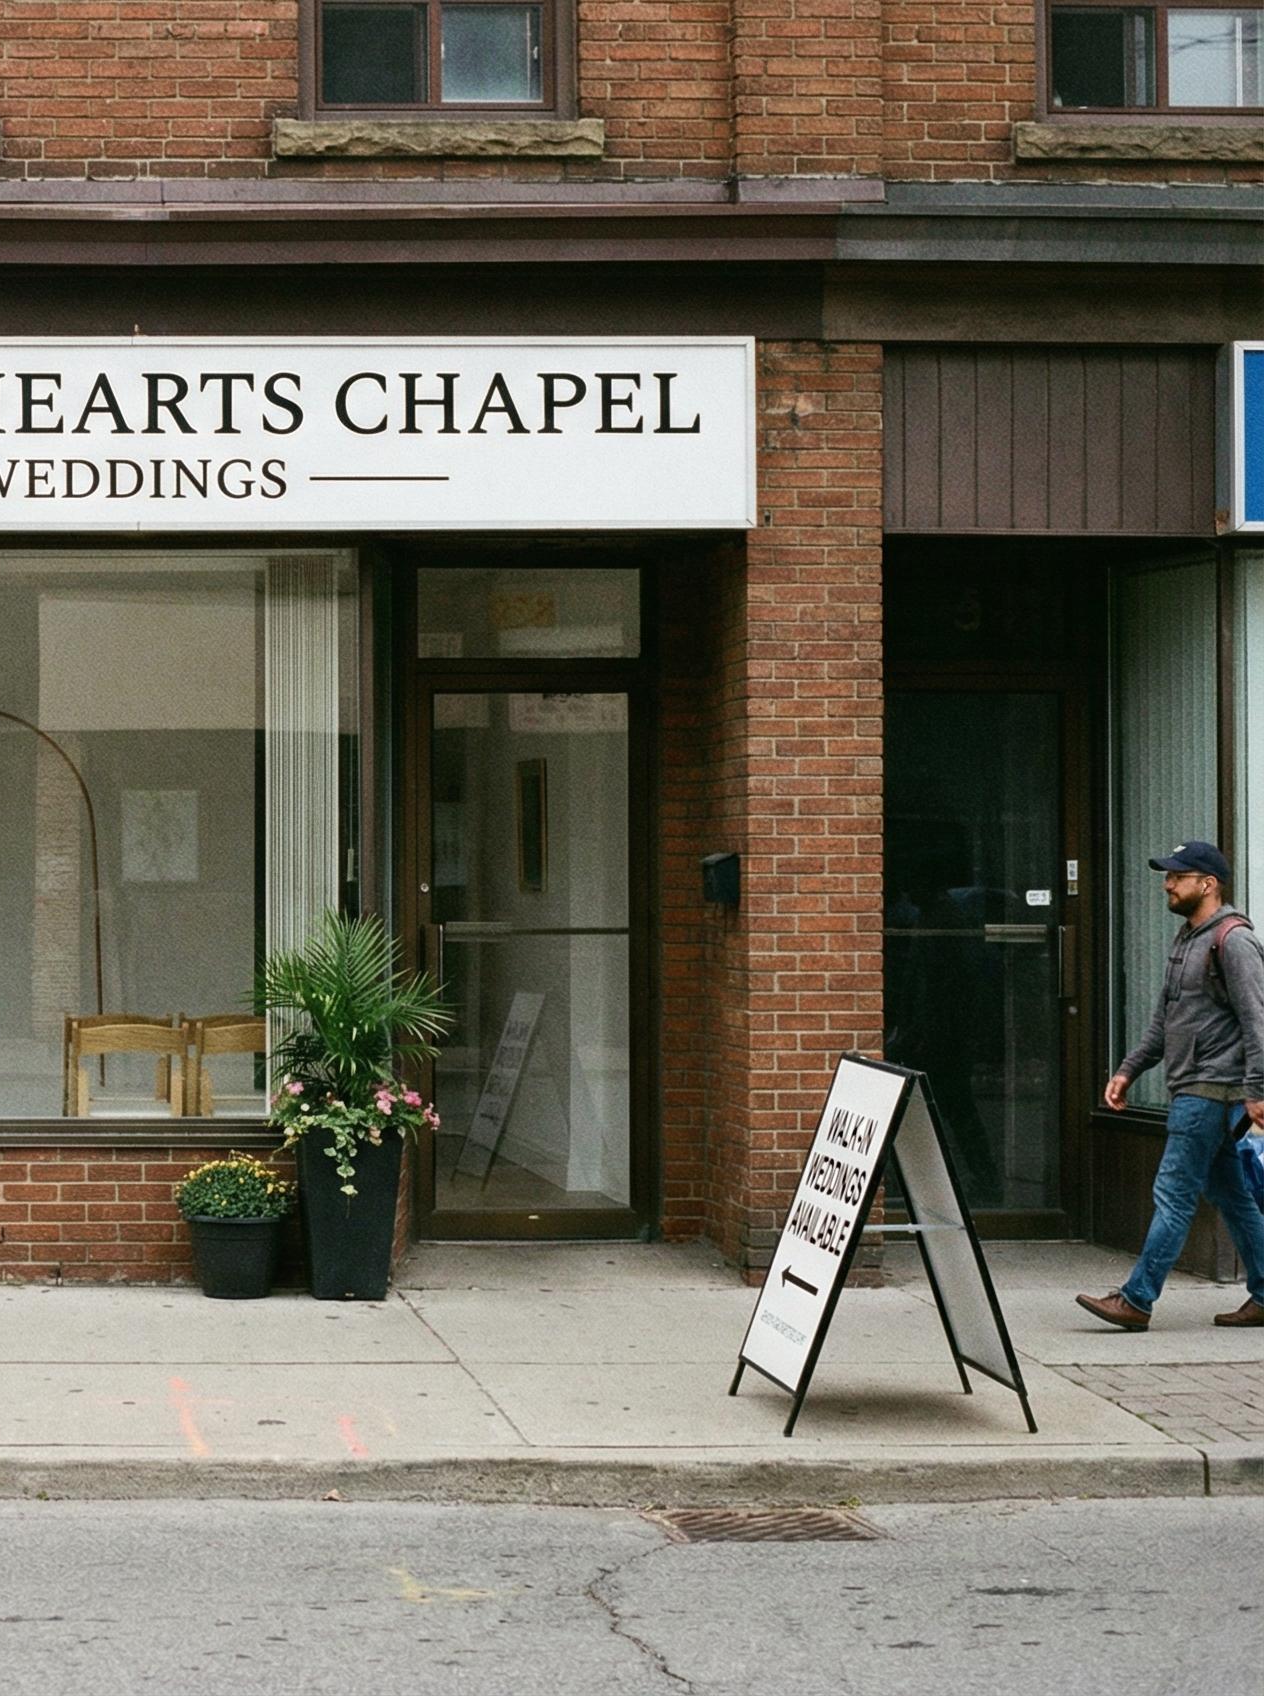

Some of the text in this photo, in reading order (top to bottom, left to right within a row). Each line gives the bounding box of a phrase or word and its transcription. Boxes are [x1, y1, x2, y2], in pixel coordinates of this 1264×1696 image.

[335, 372, 701, 435] CHAPEL
[826, 1107, 878, 1156] WALK-IN
[805, 1152, 866, 1205] WEDDINGS
[787, 1200, 850, 1256] AVAILABLE
